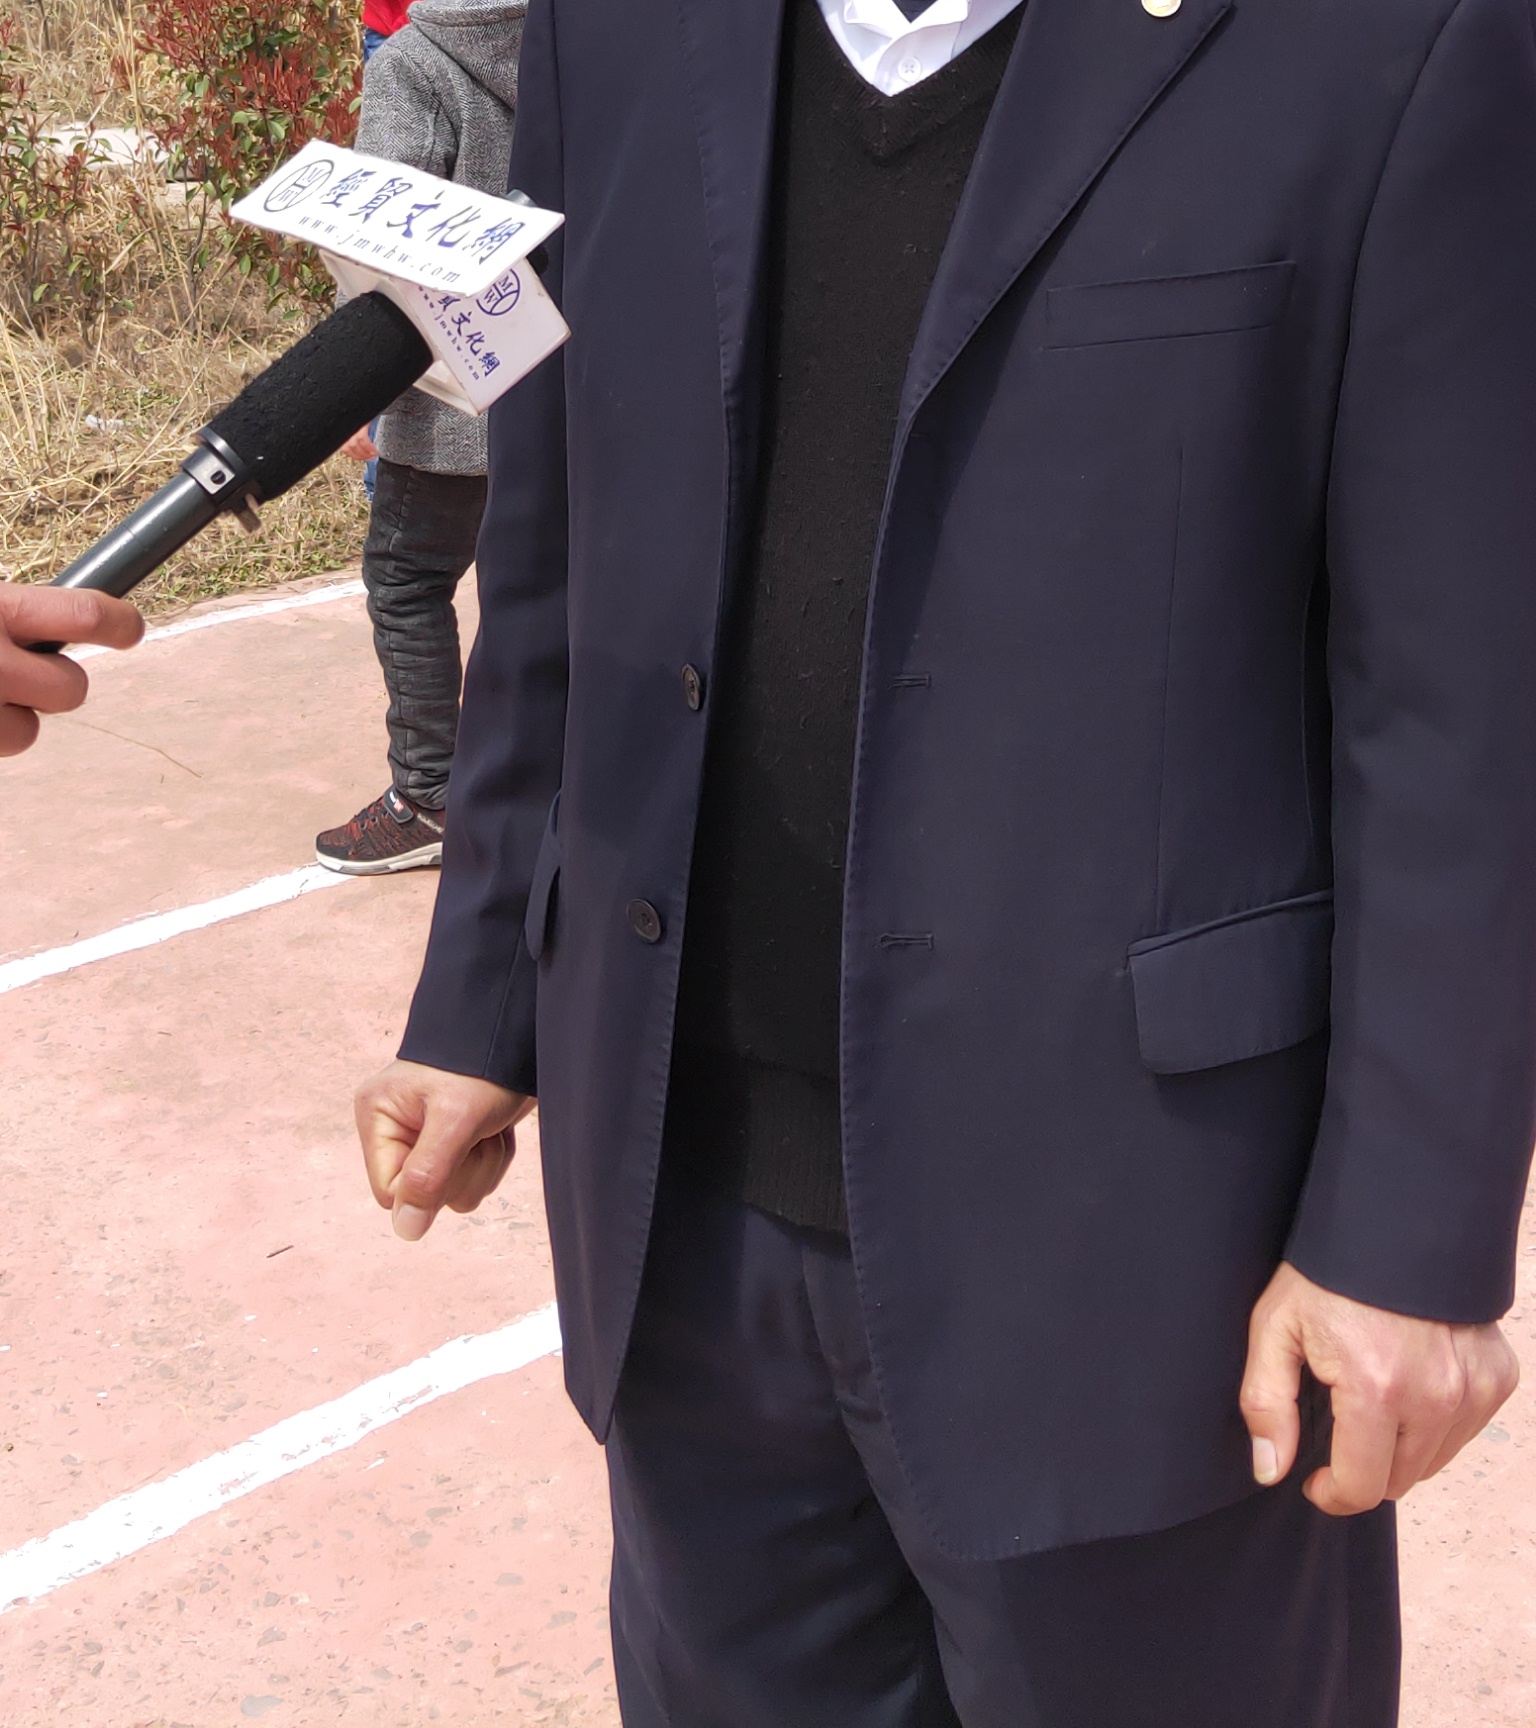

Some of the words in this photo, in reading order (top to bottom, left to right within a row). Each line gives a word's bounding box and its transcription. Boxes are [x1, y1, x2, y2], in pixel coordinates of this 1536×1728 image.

[298, 215, 462, 284] www.jmwhw.com
[320, 168, 526, 266] 經貿文化網
